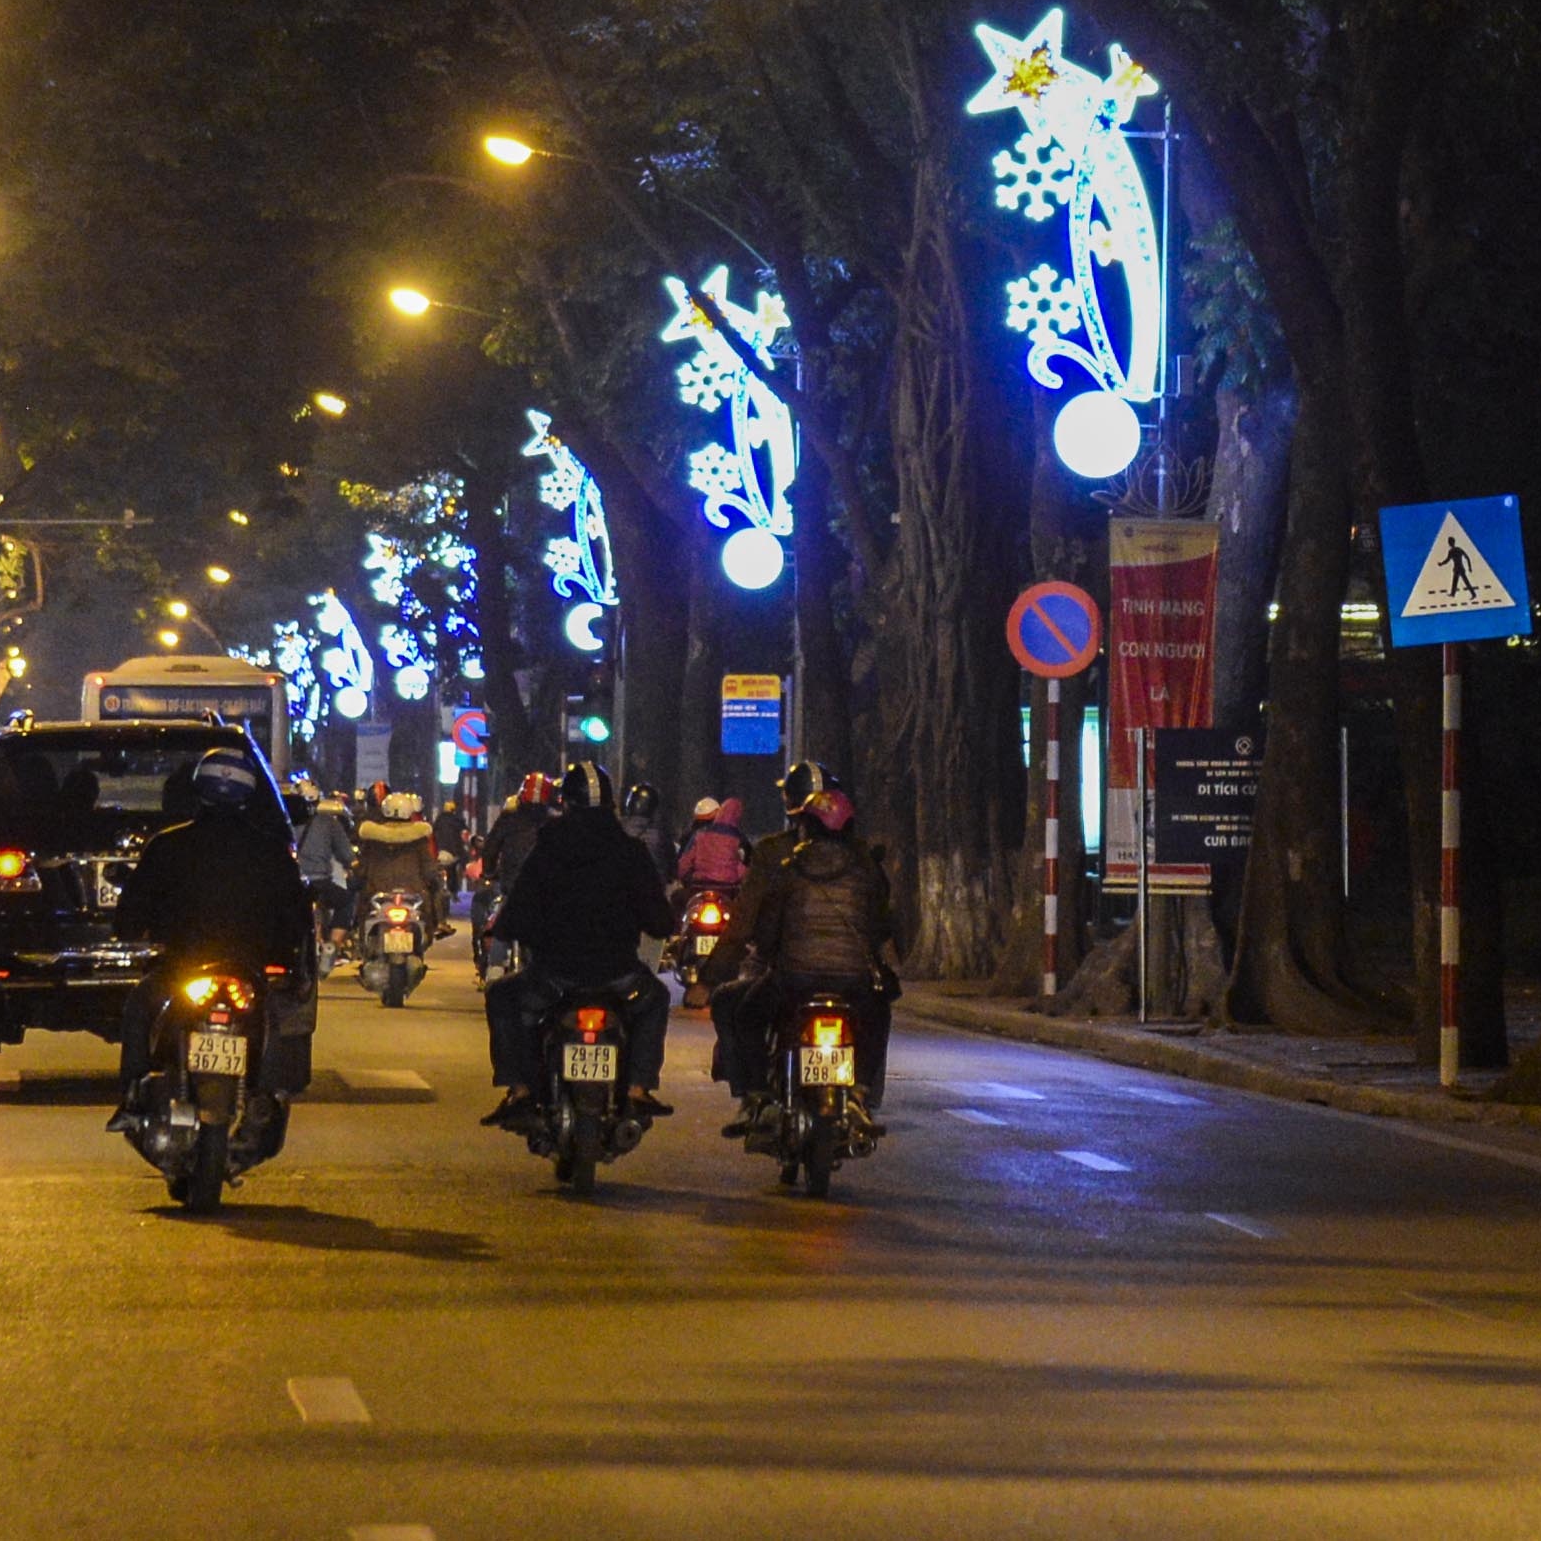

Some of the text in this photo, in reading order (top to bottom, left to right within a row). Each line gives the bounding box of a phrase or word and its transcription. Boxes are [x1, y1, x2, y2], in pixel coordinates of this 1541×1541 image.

[1119, 641, 1150, 658] CON
[1214, 781, 1238, 796] TÍCH
[571, 1063, 610, 1079] 6479
